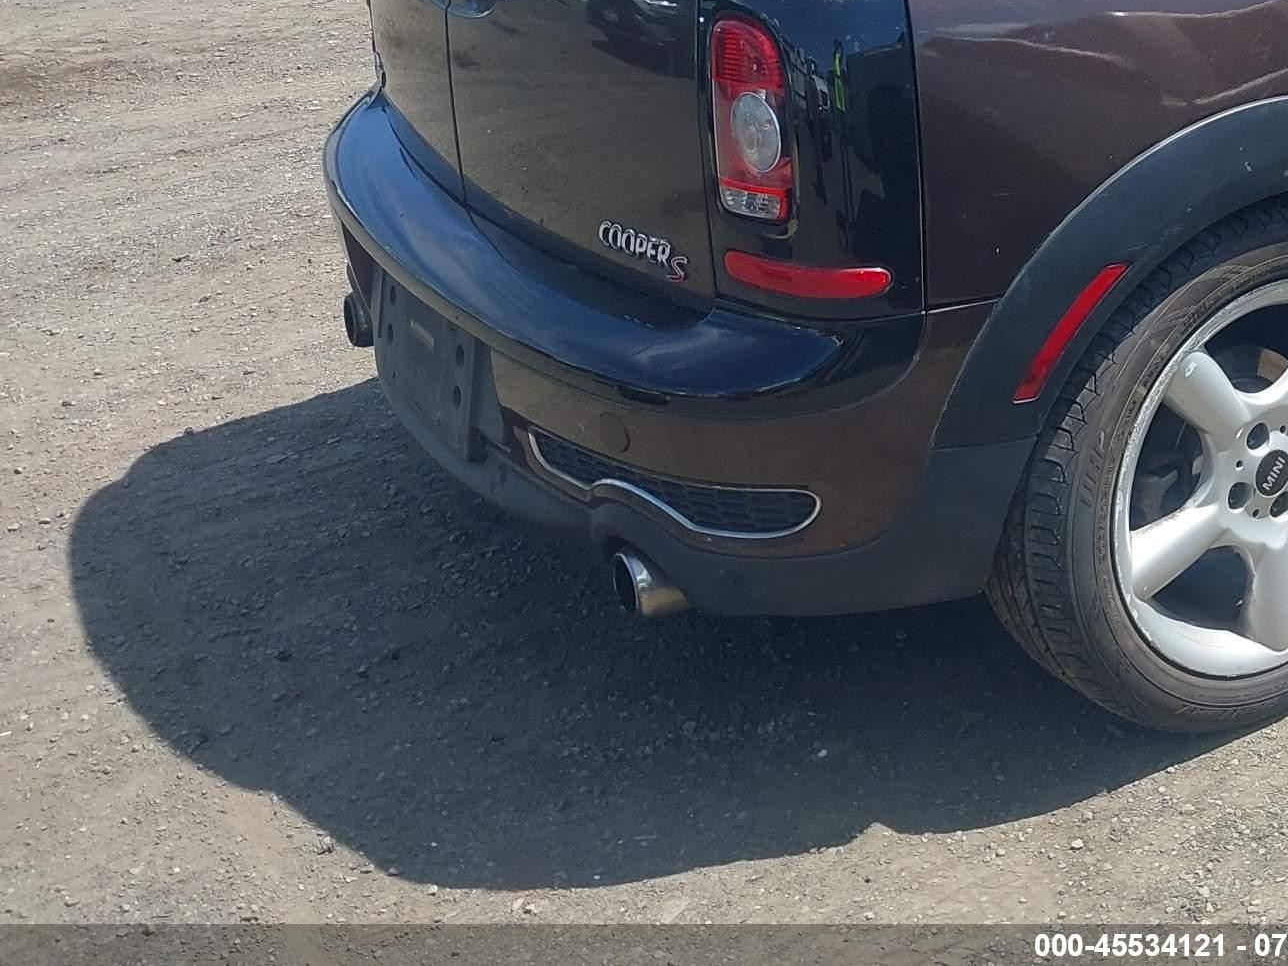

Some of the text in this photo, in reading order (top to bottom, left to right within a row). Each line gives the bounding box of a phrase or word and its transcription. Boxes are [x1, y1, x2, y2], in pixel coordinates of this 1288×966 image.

[598, 220, 689, 283] COOPER S
[1262, 456, 1286, 491] MINI
